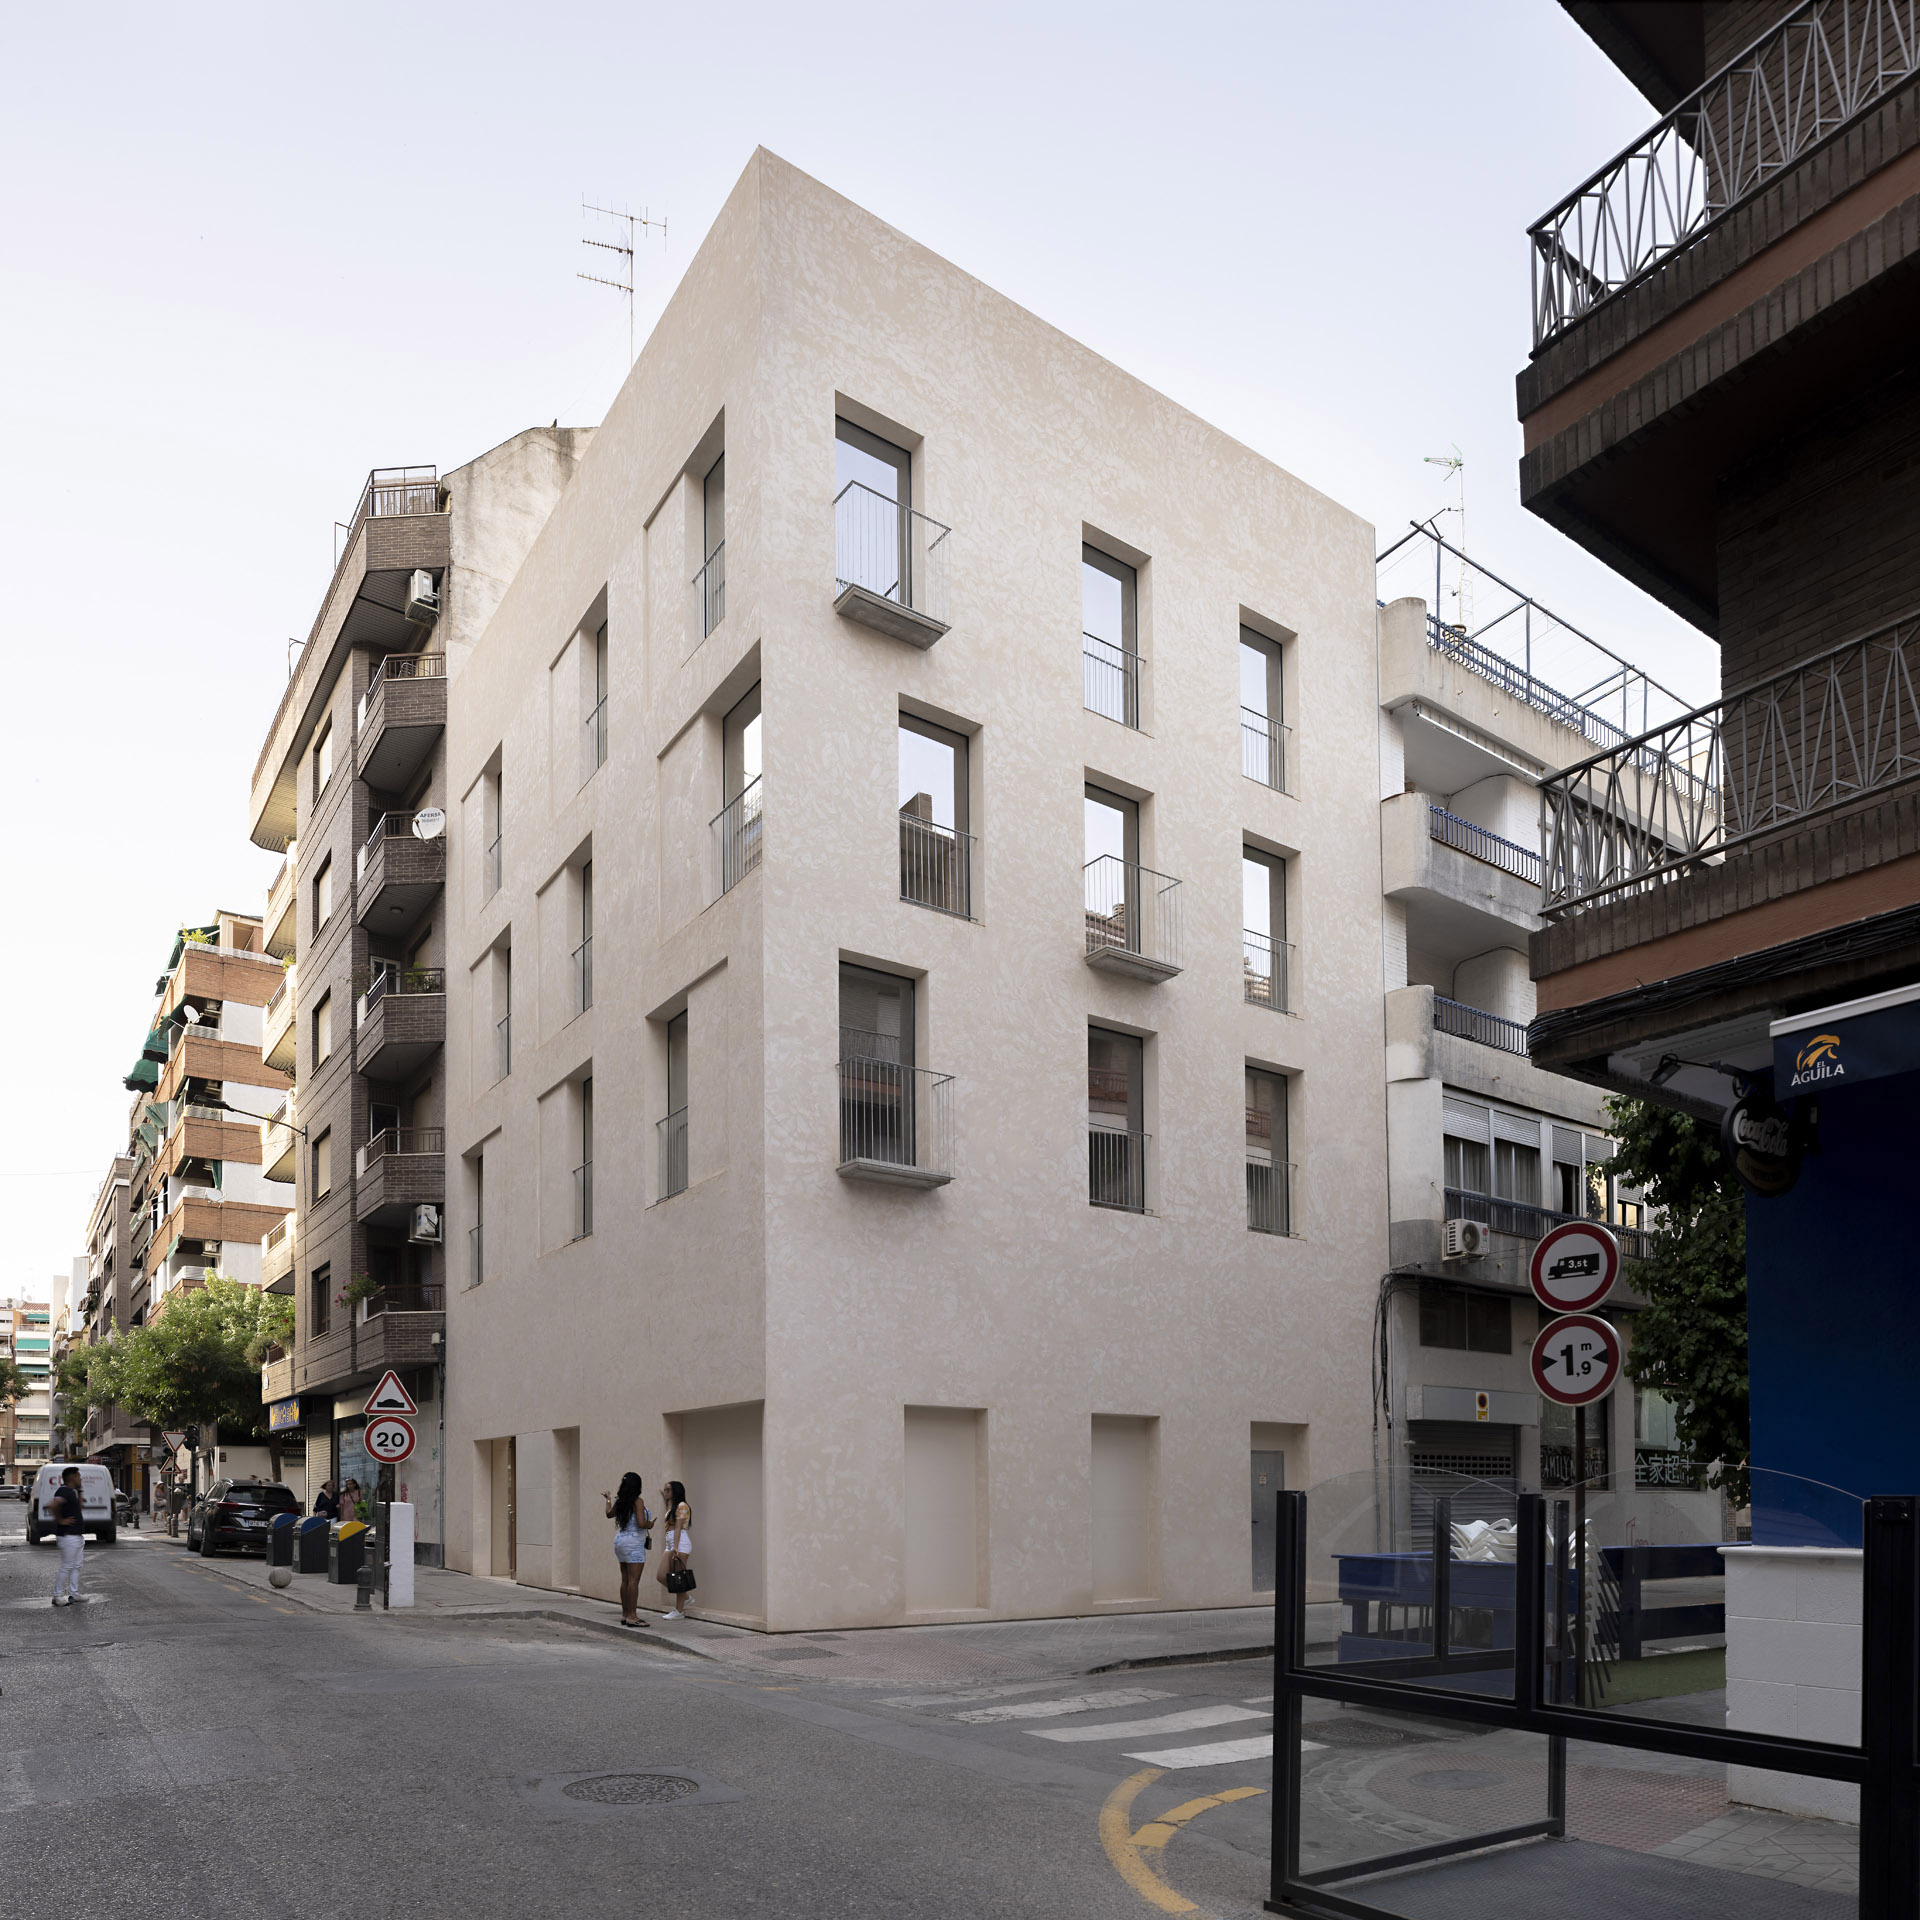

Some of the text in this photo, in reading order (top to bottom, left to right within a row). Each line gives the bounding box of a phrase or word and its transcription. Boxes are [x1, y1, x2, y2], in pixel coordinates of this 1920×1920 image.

[1816, 1060, 1826, 1069] EL
[1580, 1343, 1592, 1351] m
[376, 1432, 405, 1448] 20
[1570, 1459, 1605, 1480] MRKET
